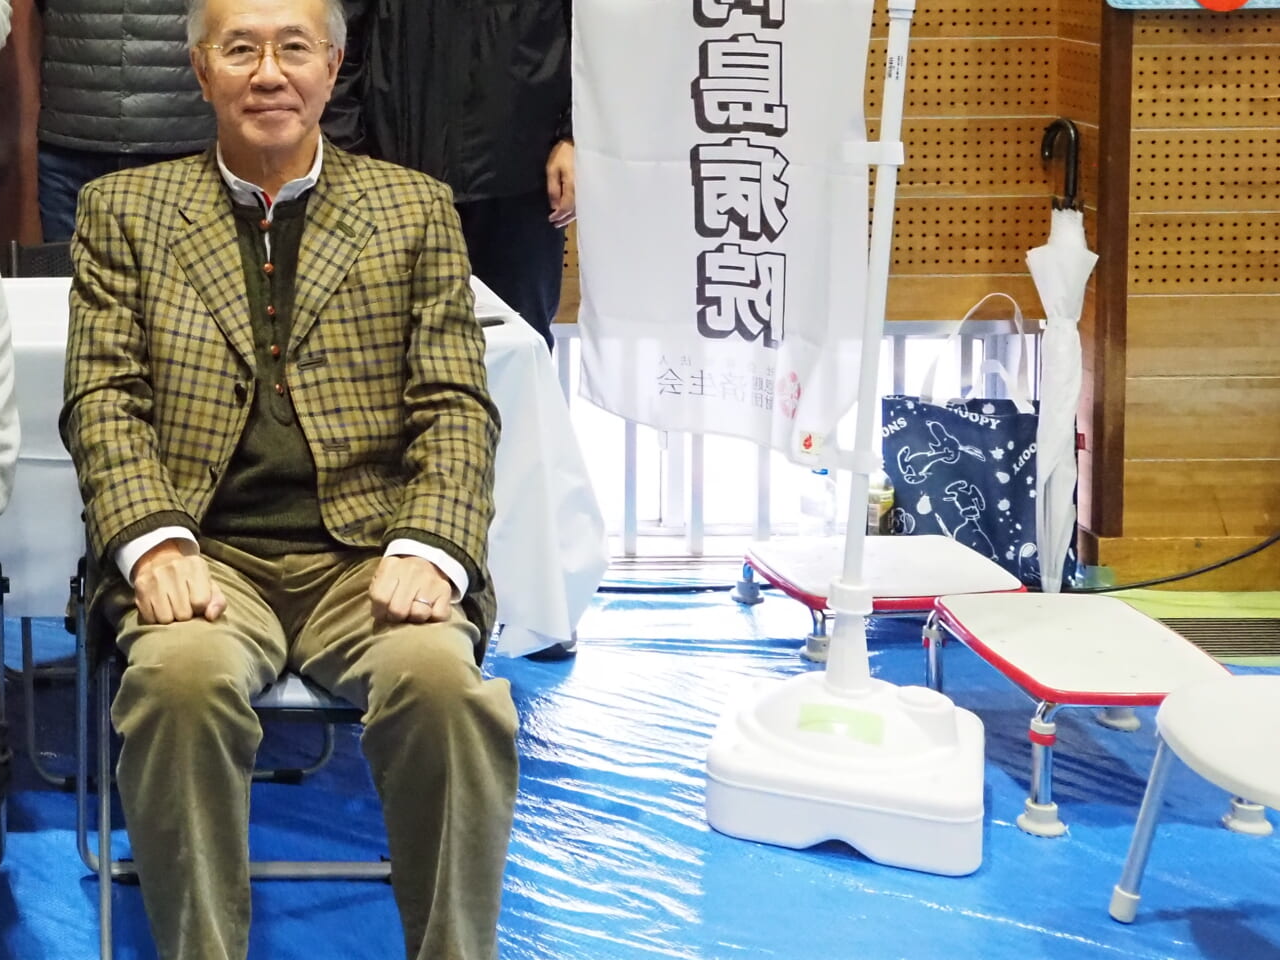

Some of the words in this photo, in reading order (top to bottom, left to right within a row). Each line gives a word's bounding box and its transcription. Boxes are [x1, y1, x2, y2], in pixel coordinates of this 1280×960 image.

[882, 416, 908, 438] ONS
[948, 405, 1001, 430] OOPY
[1012, 442, 1037, 475] OOPY
